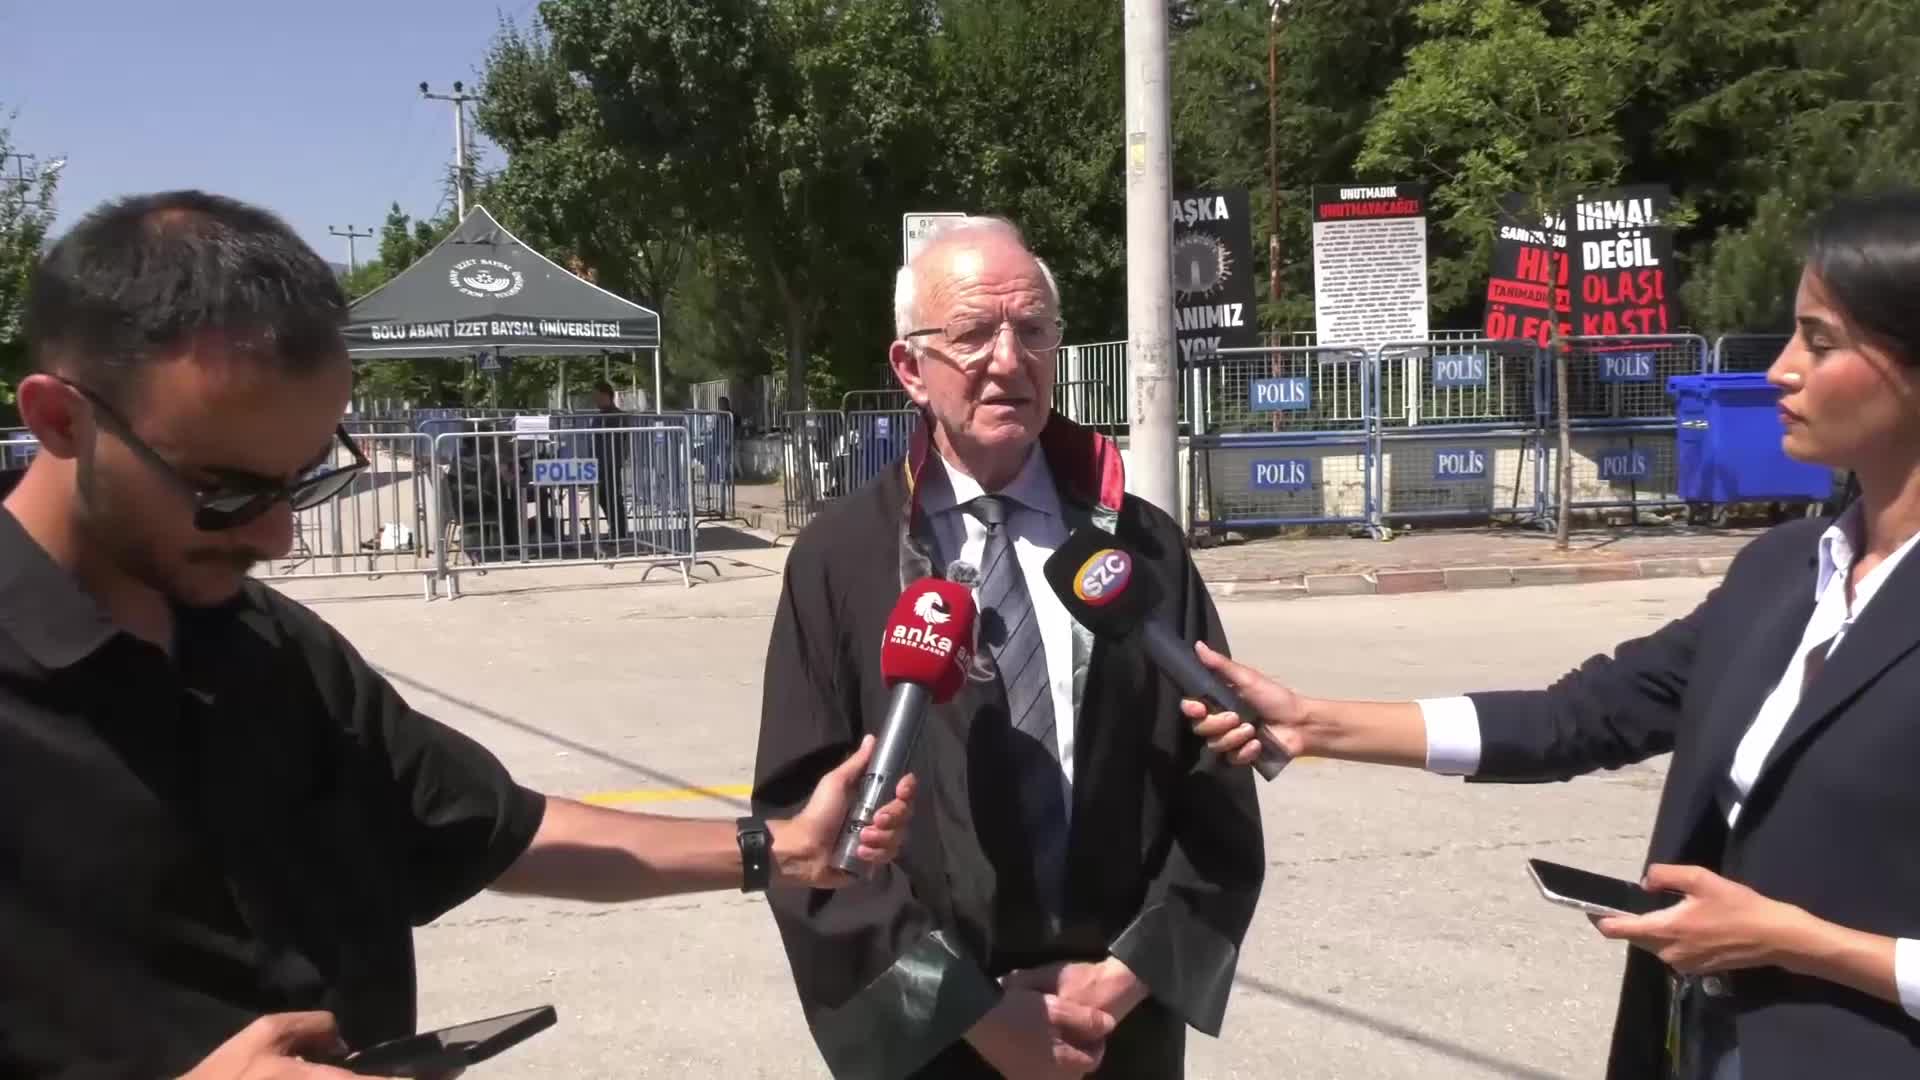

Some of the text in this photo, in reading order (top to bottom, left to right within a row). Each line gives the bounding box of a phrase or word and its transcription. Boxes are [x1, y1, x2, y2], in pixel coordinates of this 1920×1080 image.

[1340, 186, 1397, 200] UNUTMADIK
[1172, 195, 1229, 227] AŞKA
[1582, 230, 1660, 271] DEĞİL
[372, 319, 621, 340] BOLU ABANT İZZET BAYSAL ÜNİVERSİTESİ
[1174, 303, 1244, 331] ANIMIZ
[1437, 355, 1483, 381] POLİS
[1605, 353, 1650, 377] POLİS
[1257, 379, 1305, 404] POLİS
[1257, 460, 1305, 484] POLİS
[1438, 450, 1484, 475] POLİS
[1603, 451, 1646, 476] POLİS
[1083, 555, 1125, 597] SZC
[893, 624, 952, 654] anka
